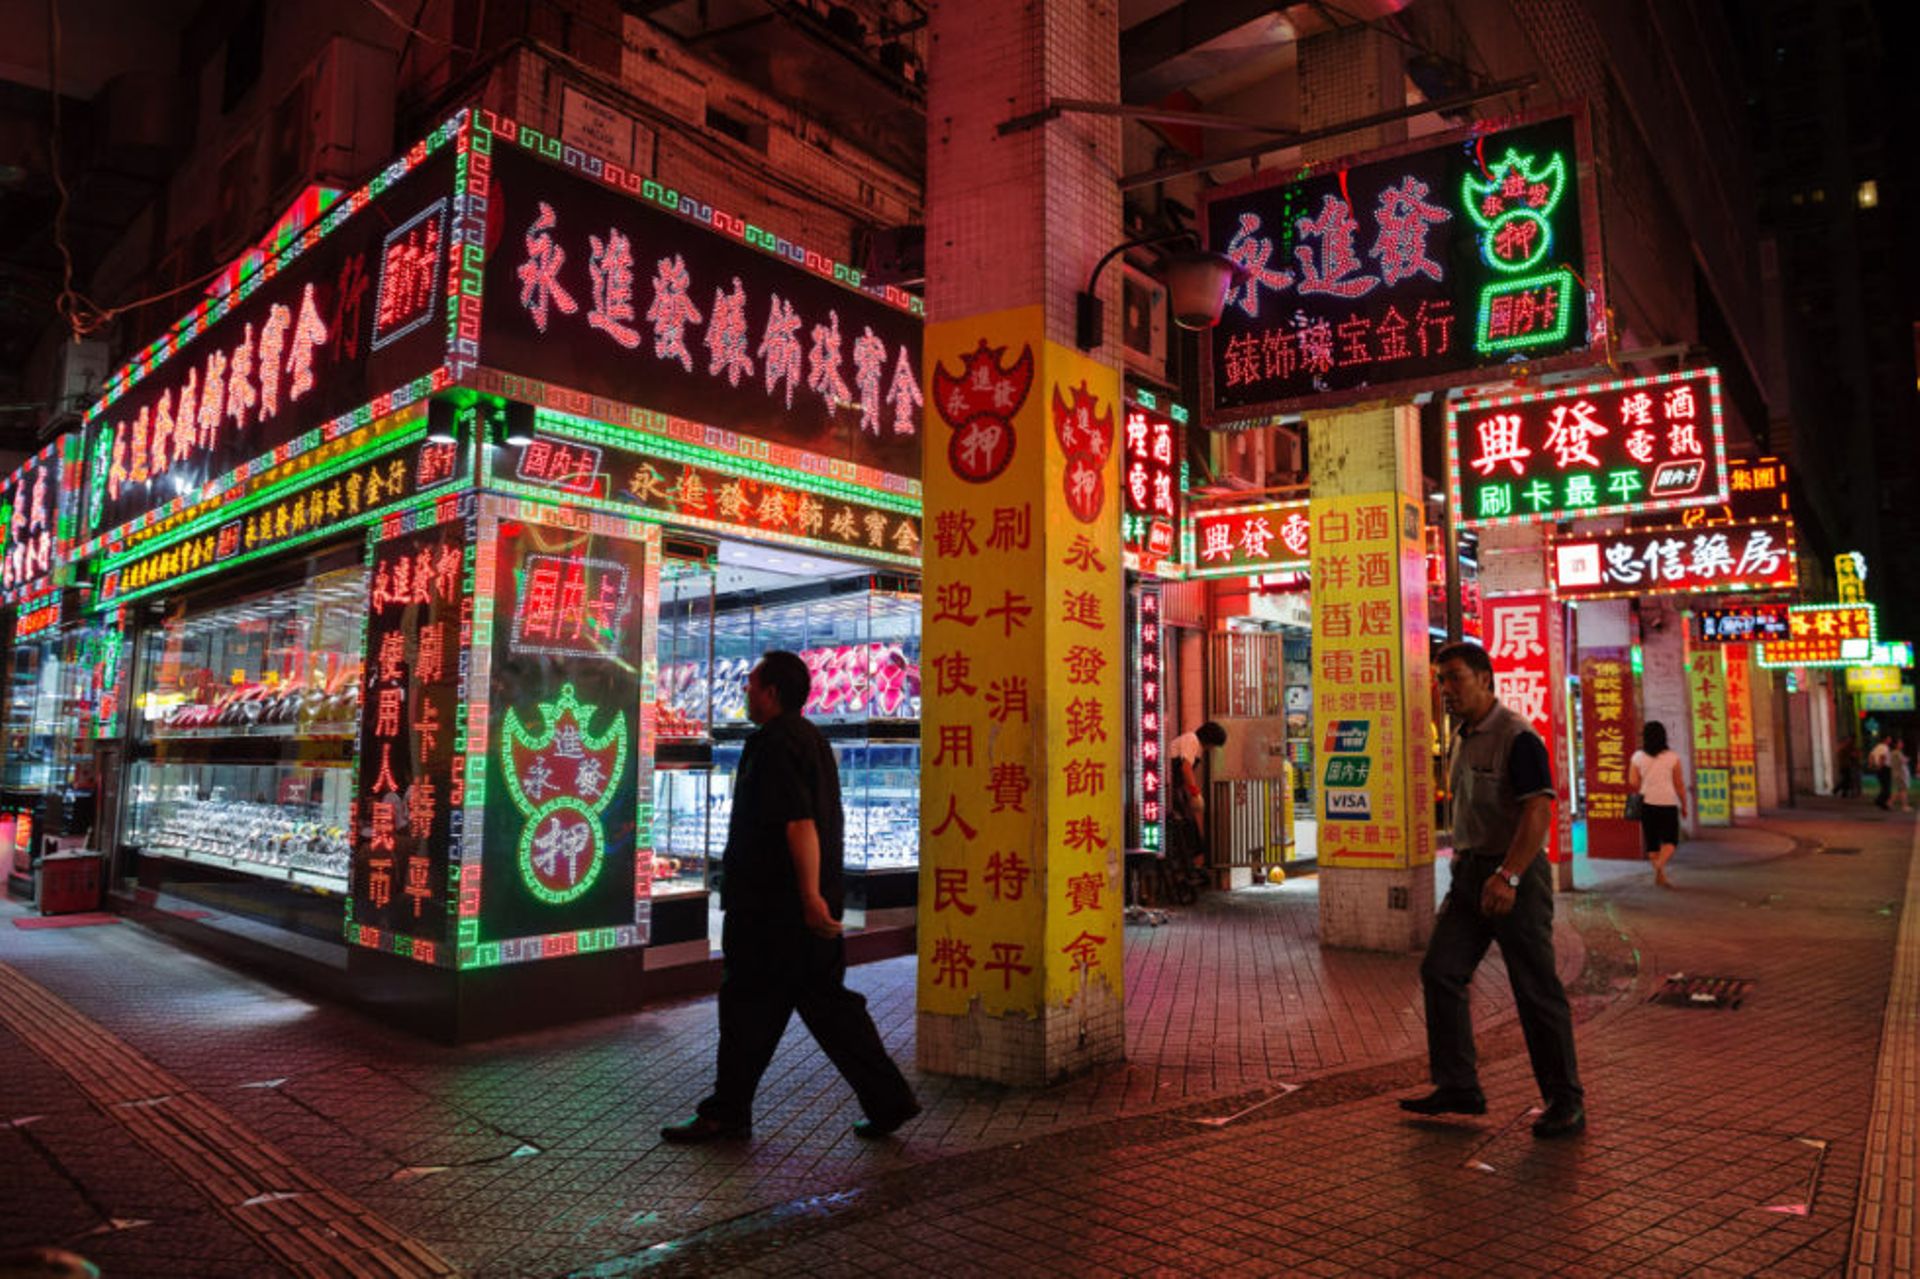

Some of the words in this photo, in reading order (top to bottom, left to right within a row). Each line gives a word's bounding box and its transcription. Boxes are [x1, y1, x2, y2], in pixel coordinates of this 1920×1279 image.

[1223, 175, 1453, 317] 永進發
[1495, 219, 1538, 259] 押
[518, 201, 923, 437] 永進發錶飾珠寶金
[1621, 386, 1696, 427] 煙酒
[961, 422, 1001, 474] 押
[1471, 400, 1609, 477] 興發
[1625, 424, 1703, 464] 電訊
[1071, 460, 1099, 512] 押
[1479, 470, 1644, 516] 刷卡最平
[1730, 466, 1777, 490] 集團
[629, 460, 919, 552] 永進發錶飾珠寶金
[1318, 505, 1390, 544] 白酒
[1202, 514, 1311, 562] 興發電
[1602, 530, 1788, 583] 忠信藥房
[1318, 552, 1391, 591] 洋酒
[1320, 600, 1393, 639] 香煙
[1321, 647, 1394, 685] 電訊
[931, 508, 980, 989] 歡迎使用人民幣
[983, 501, 1034, 992] 刷卡消費特平
[1062, 534, 1107, 973] 永進發錶飾珠寶金
[1332, 793, 1366, 809] VISA
[534, 816, 591, 886] 押
